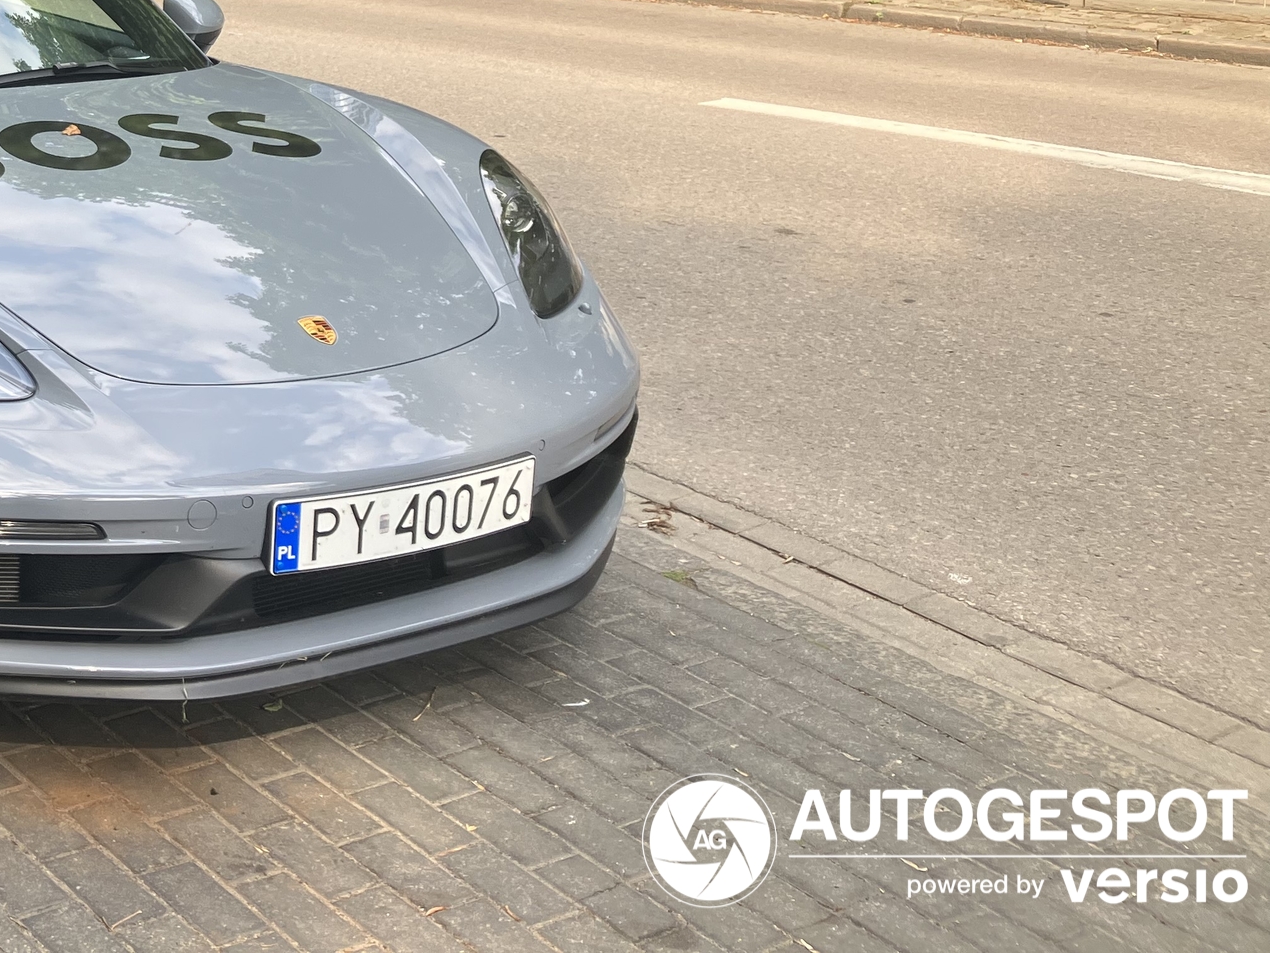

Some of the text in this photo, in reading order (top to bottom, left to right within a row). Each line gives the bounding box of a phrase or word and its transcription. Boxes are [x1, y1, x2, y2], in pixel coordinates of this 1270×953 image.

[311, 469, 523, 561] PY 40076
[277, 545, 296, 561] PL
